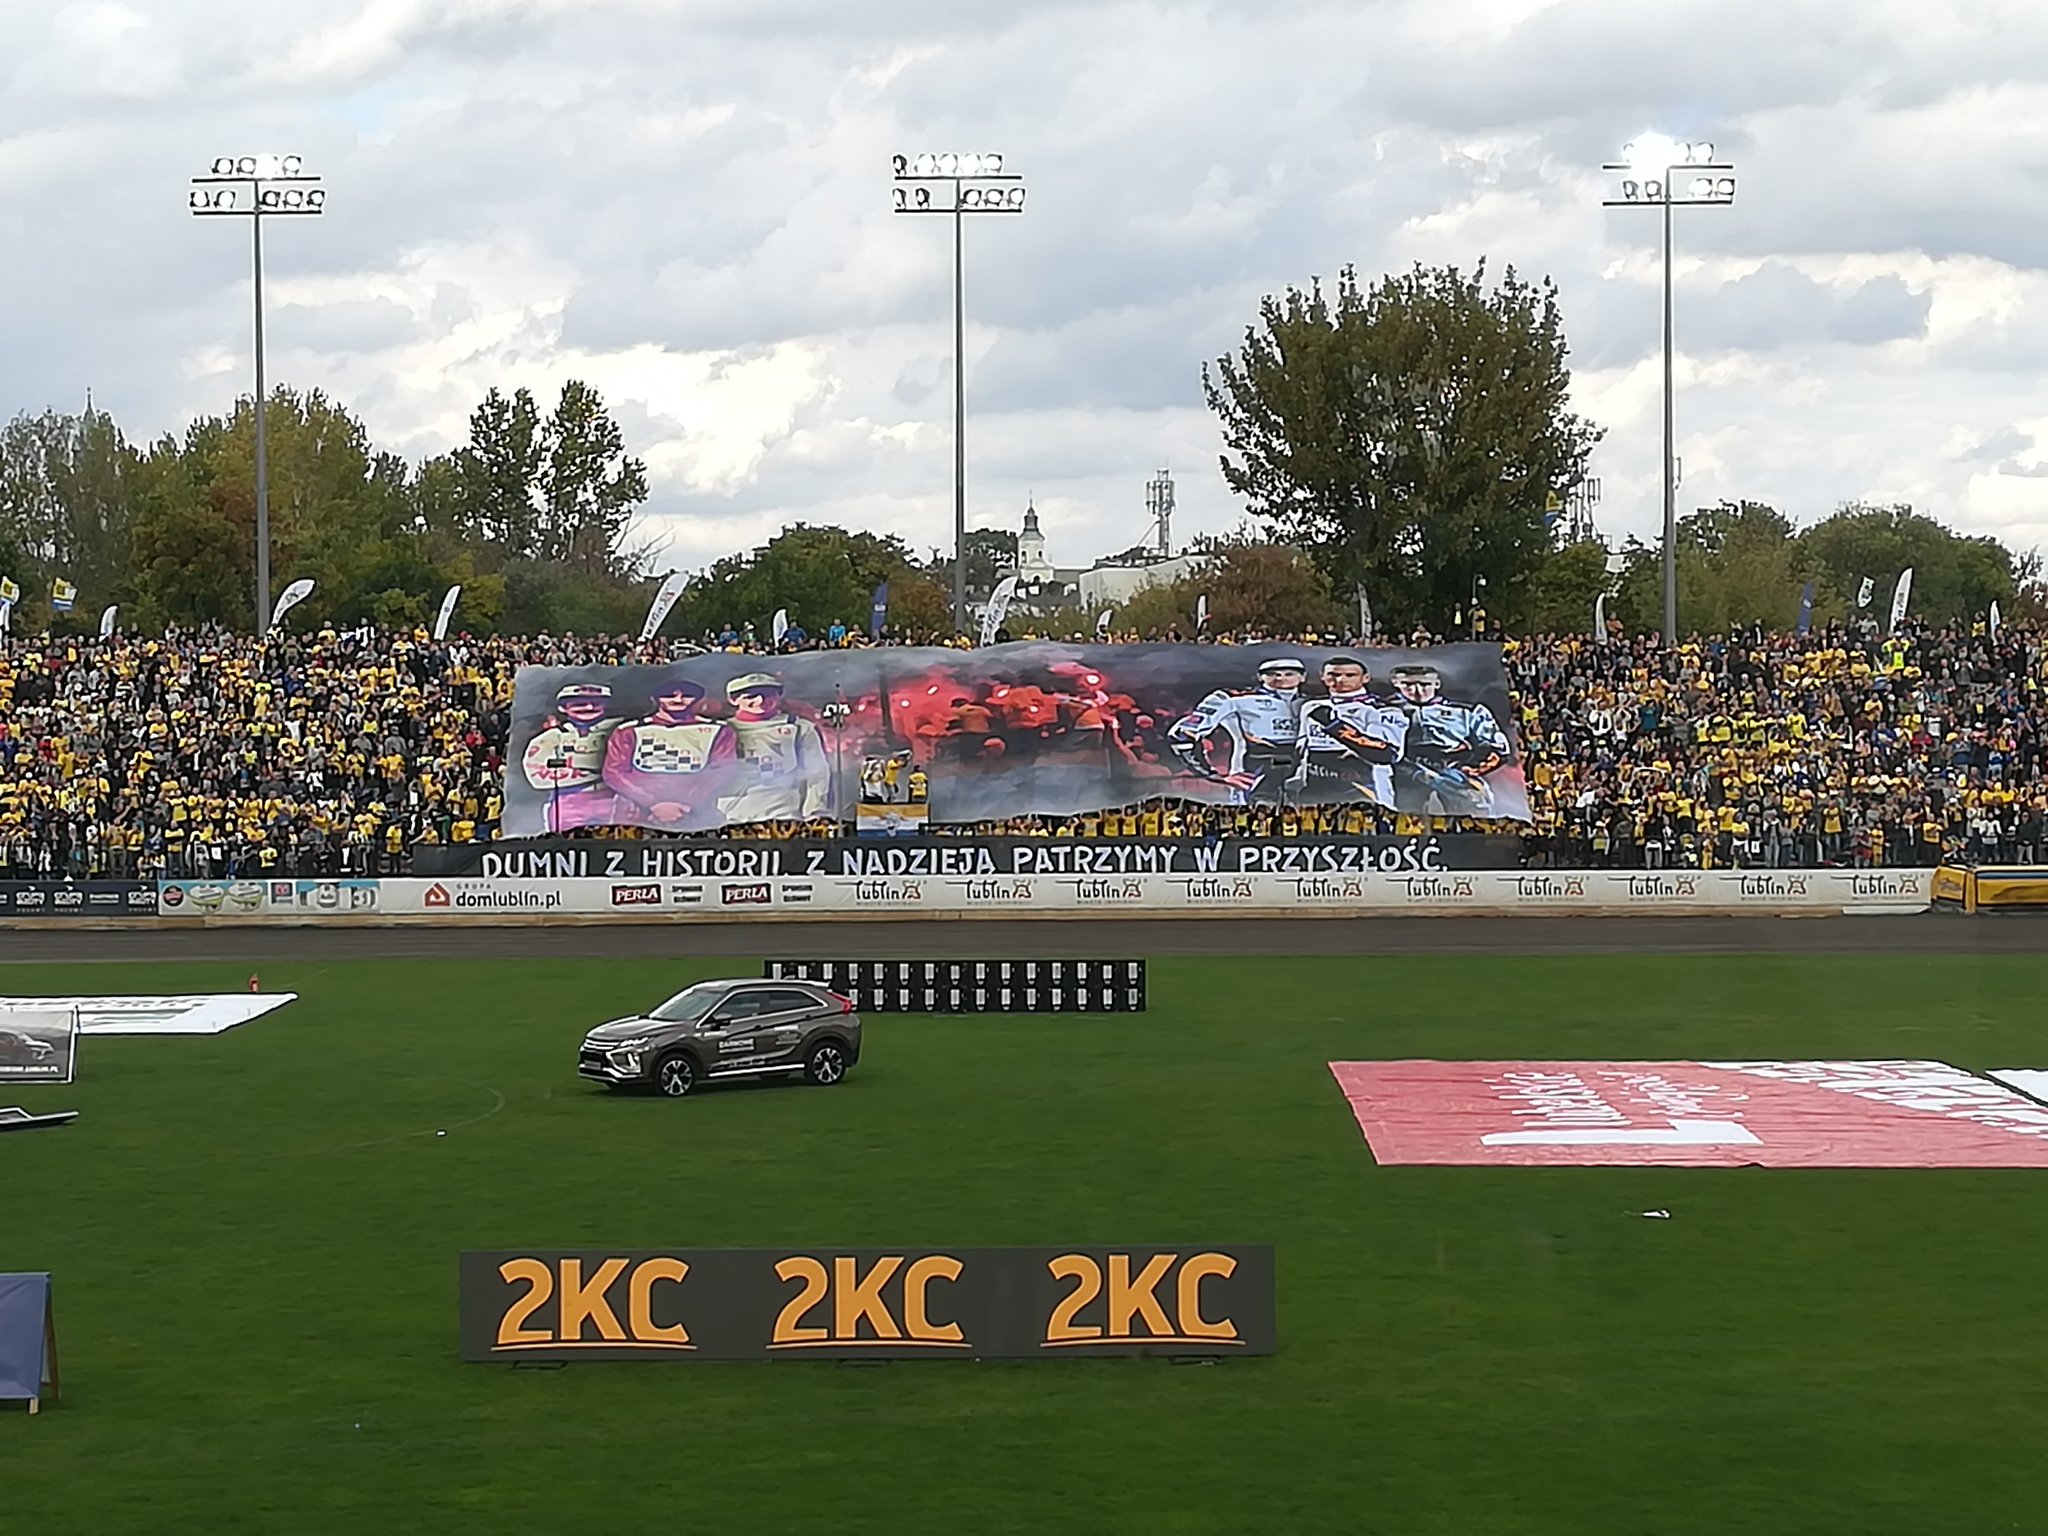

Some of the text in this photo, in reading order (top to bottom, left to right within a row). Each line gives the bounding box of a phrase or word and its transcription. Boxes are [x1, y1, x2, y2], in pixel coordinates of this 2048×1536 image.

[456, 891, 561, 908] domlublin.pl
[482, 850, 587, 878] DUMNI
[605, 851, 625, 876] Z
[642, 849, 789, 876] HISTORII
[807, 850, 825, 875] Z
[1013, 846, 1178, 873] PATRZYMY
[1194, 841, 1223, 872] W
[1240, 838, 1448, 873] PRZYSZŁOŚĆ.
[497, 1257, 690, 1345] 2KC
[774, 1255, 965, 1343] 2KC
[1047, 1253, 1238, 1342] 2KC
